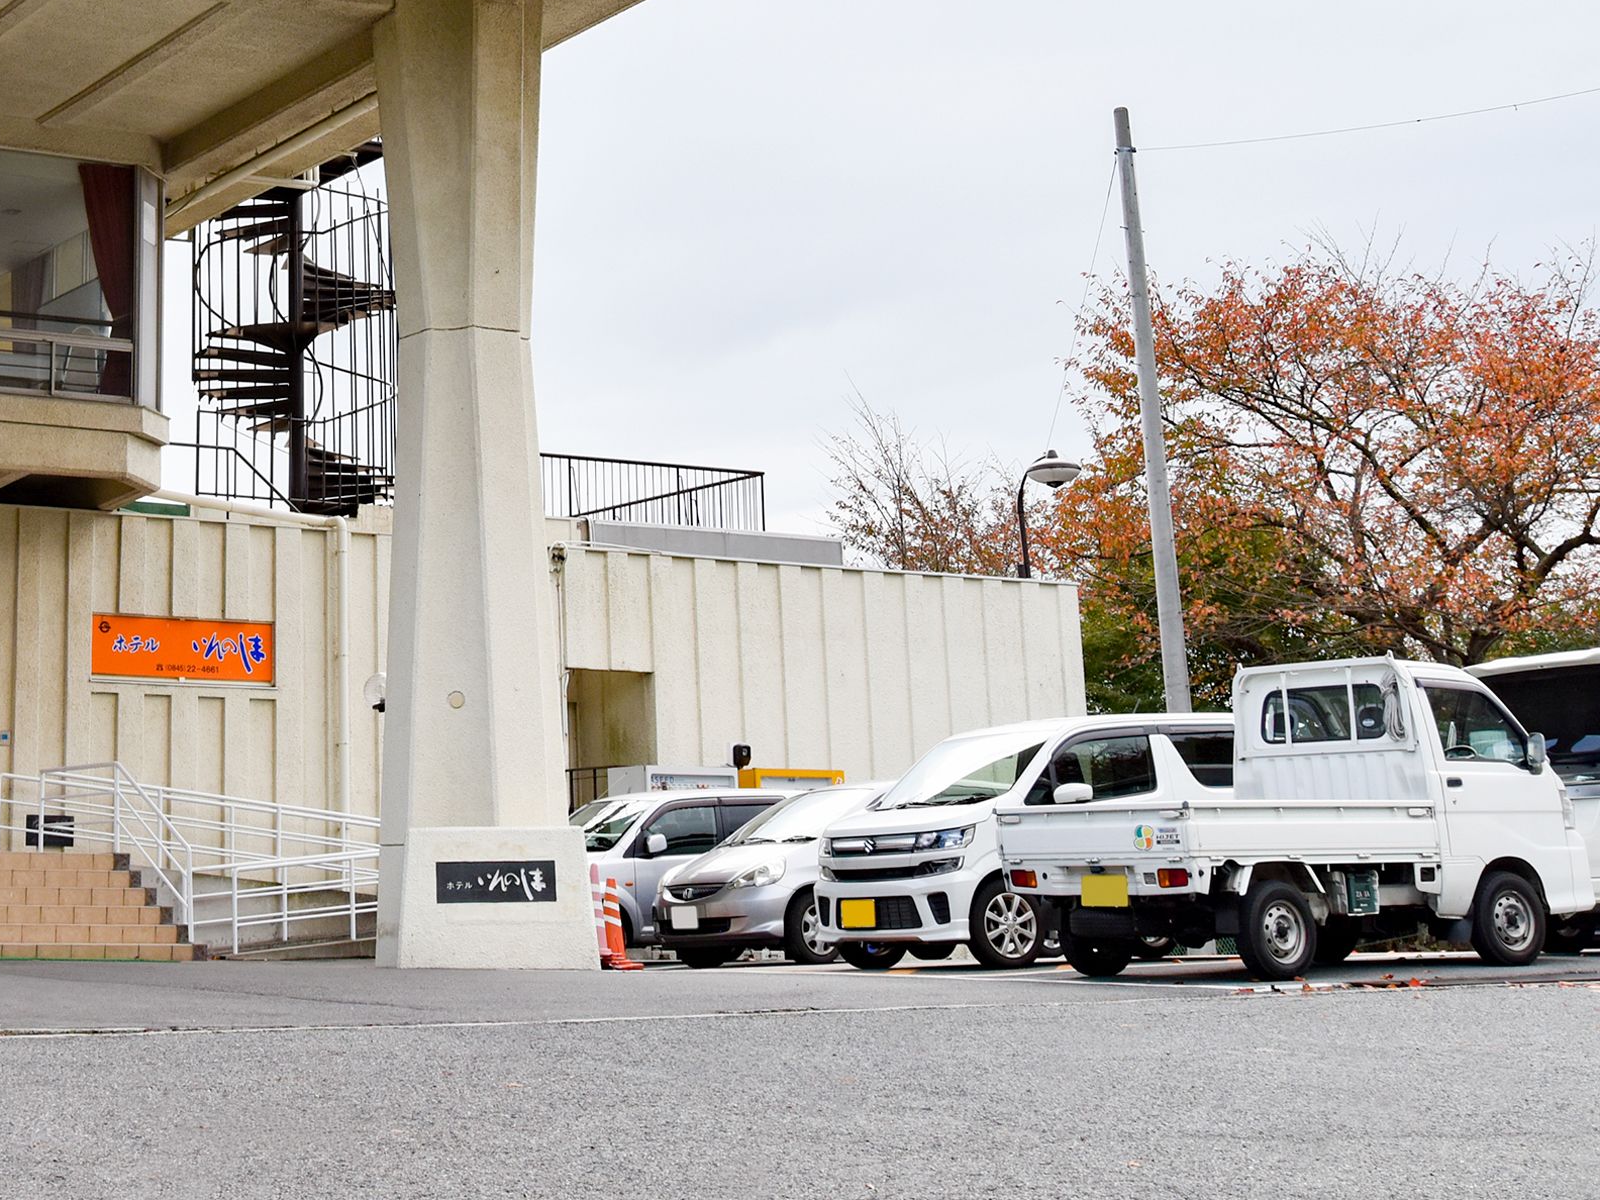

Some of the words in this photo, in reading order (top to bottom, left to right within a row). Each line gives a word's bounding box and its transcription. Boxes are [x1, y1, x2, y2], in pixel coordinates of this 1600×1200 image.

[113, 634, 159, 653] ホテル
[191, 632, 266, 673] いんのしま
[446, 881, 473, 890] ホテル
[477, 868, 546, 901] いんのしま
